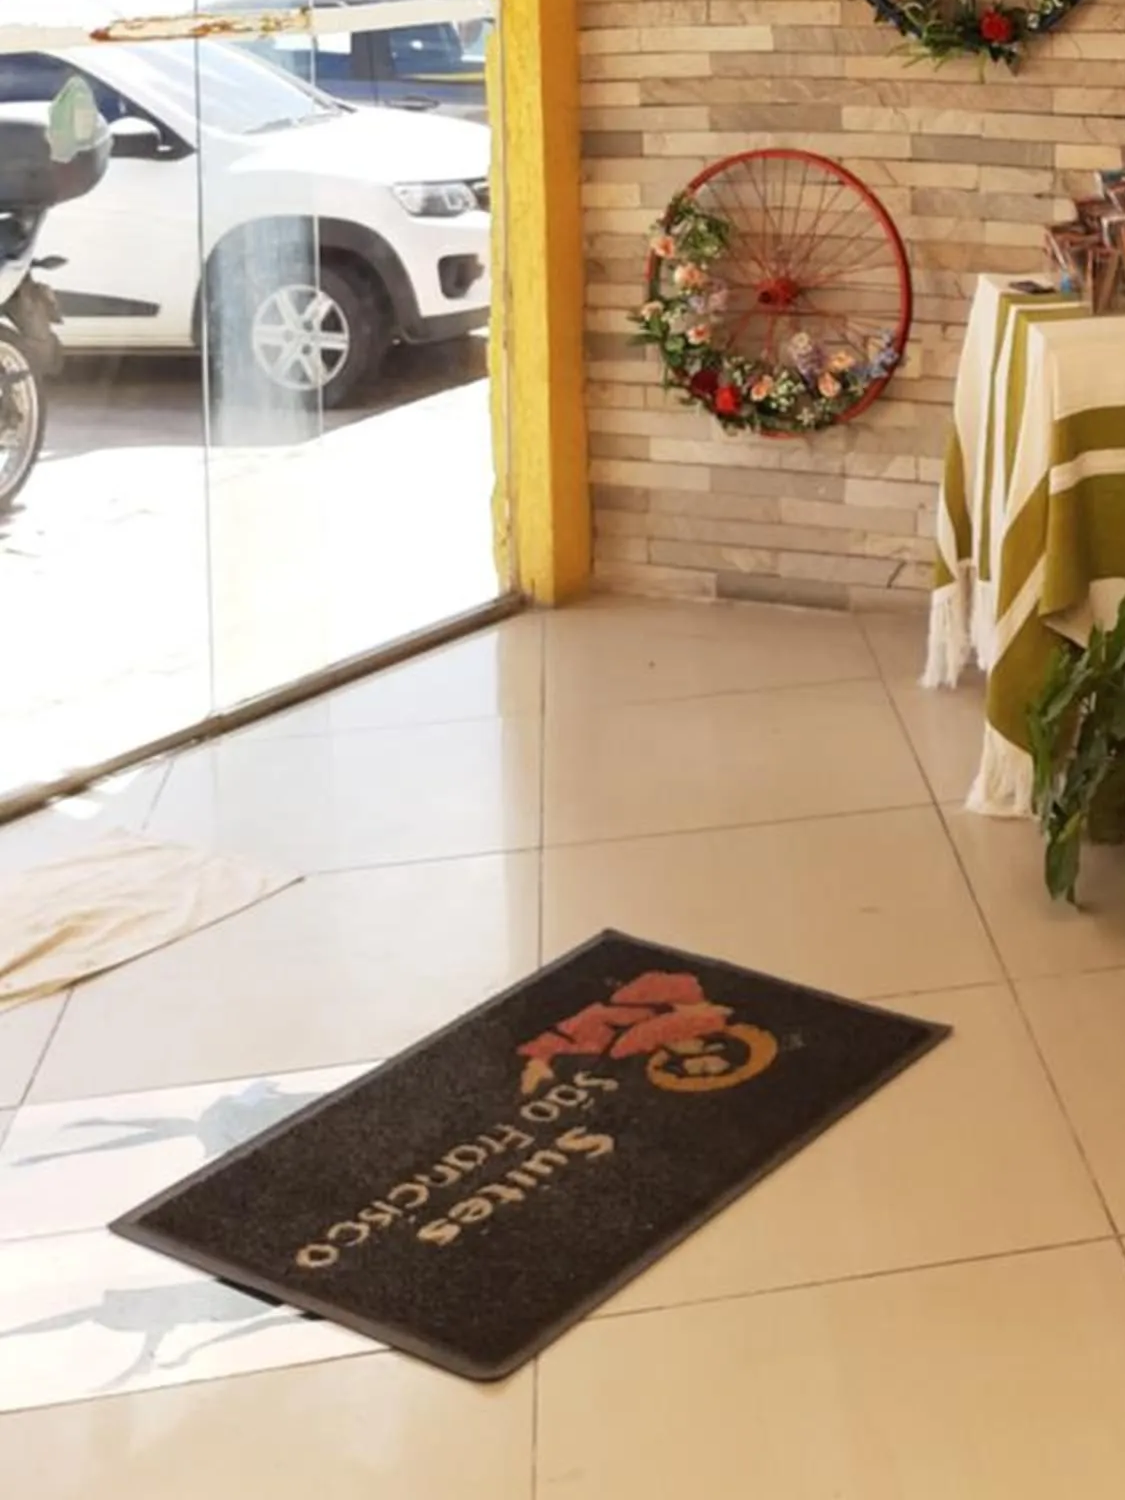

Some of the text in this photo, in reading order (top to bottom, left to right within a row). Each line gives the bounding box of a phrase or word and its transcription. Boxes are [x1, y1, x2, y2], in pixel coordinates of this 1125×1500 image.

[296, 1070, 619, 1268] São Francisco
[417, 1127, 614, 1246] Suites
